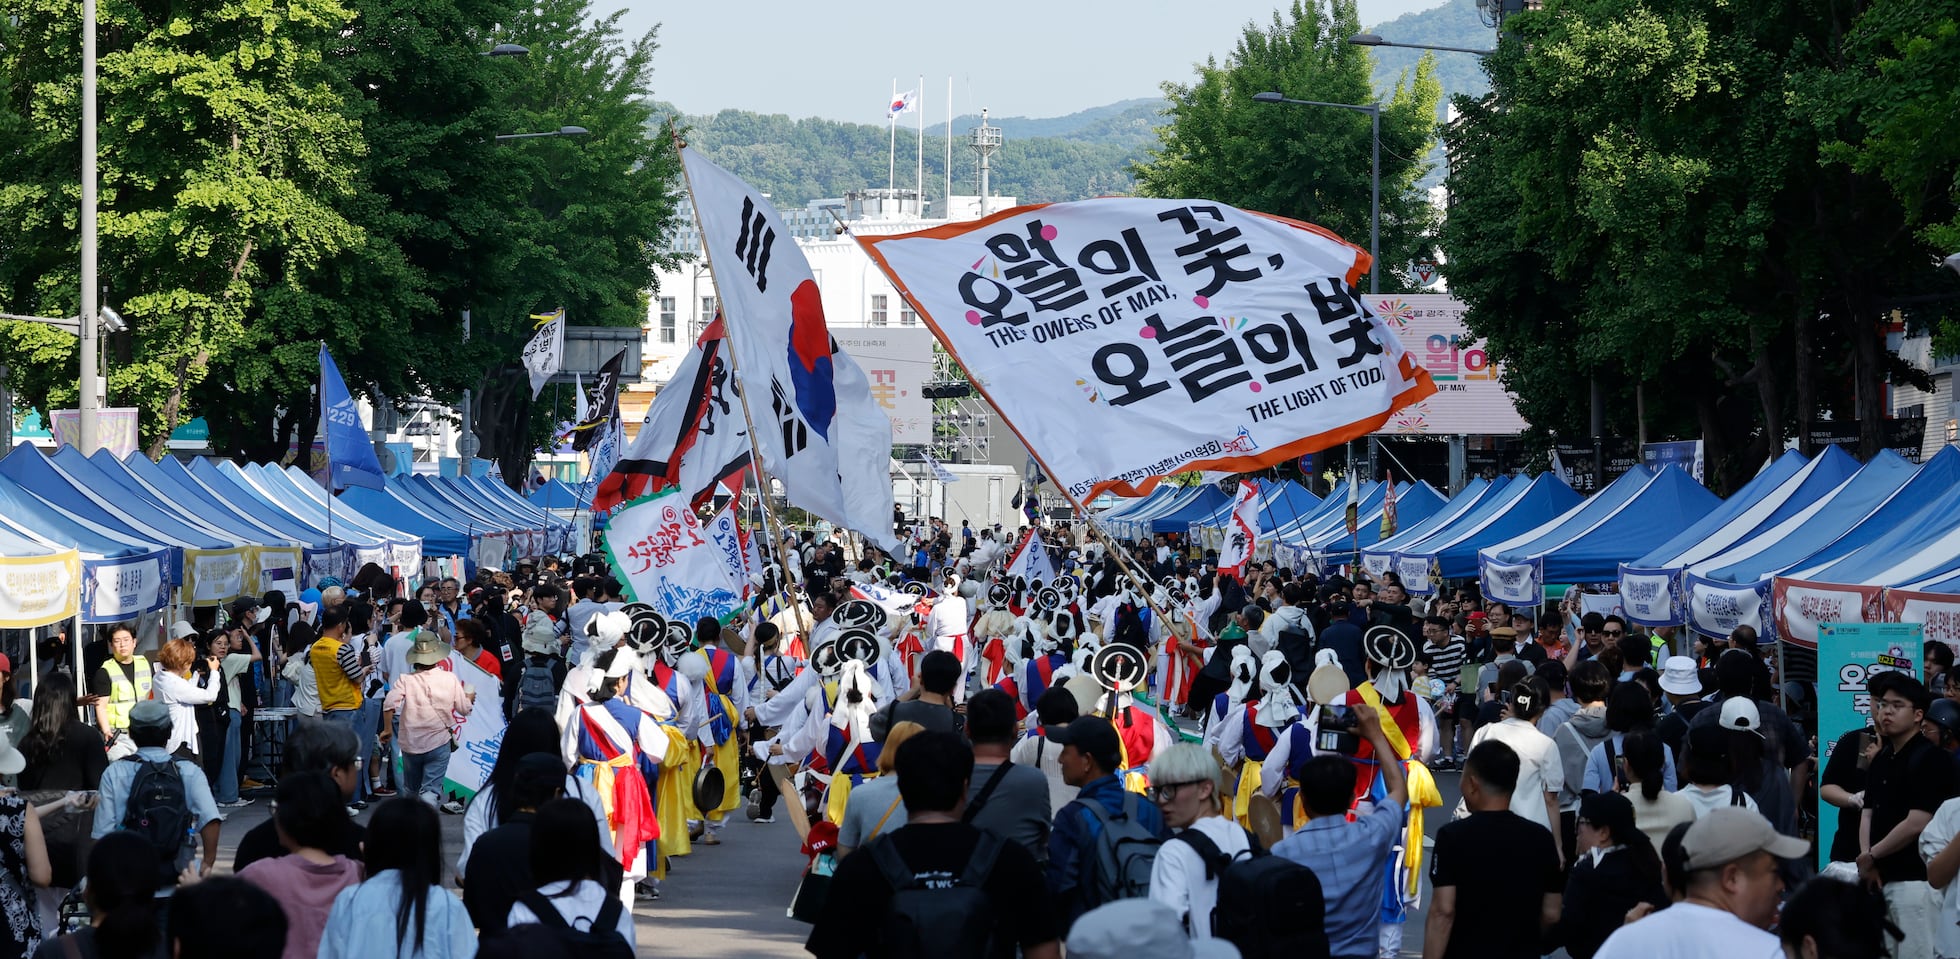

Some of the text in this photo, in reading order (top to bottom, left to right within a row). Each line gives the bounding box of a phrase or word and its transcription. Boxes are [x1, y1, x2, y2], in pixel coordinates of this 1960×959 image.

[958, 206, 1285, 328] 오월의 꽃,
[837, 340, 861, 348] 주주의
[985, 284, 1178, 349] THE OWERS OF MAY,
[1092, 276, 1383, 407] 오늘의 빛
[1406, 334, 1498, 381] 월의
[1246, 364, 1386, 424] THE LIGHT OF TOD
[812, 840, 828, 850] KIA
